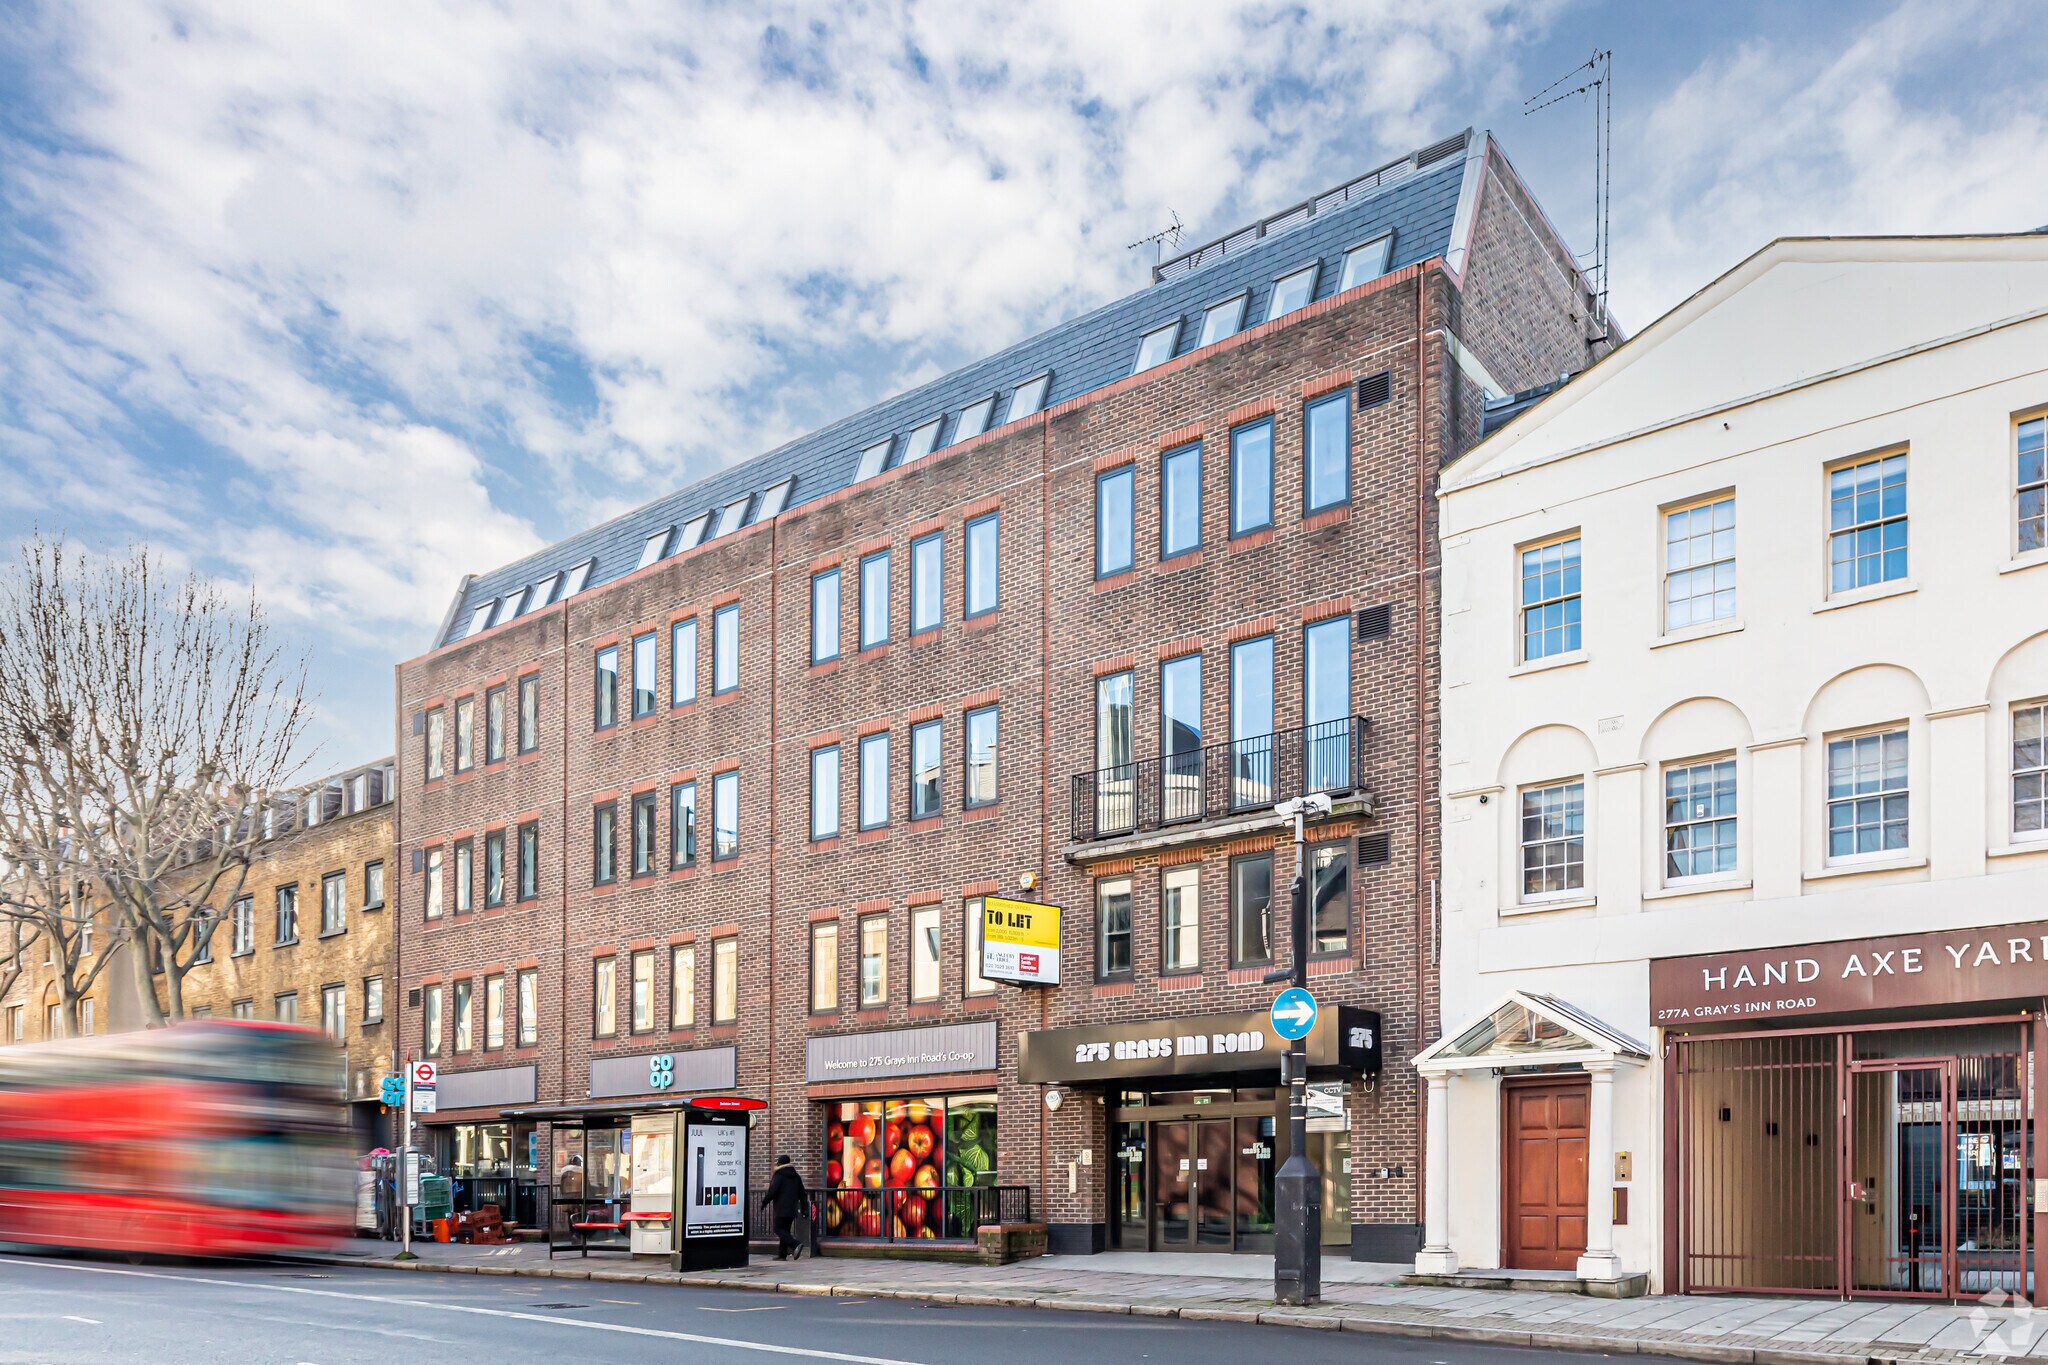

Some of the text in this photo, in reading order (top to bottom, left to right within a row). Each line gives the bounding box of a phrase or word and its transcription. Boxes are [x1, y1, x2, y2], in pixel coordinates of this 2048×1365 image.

[987, 910, 1032, 929] TO LET
[1702, 958, 1820, 991] HAND
[1841, 948, 1923, 979] AXE
[1658, 997, 1817, 1020] 277A GRAY'S INN ROAD
[1075, 1031, 1264, 1063] 275 GRAYS INN ROAD
[1348, 1027, 1373, 1049] 275
[824, 1051, 975, 1070] Welcome to 275 Grays Inn Road's Co-op
